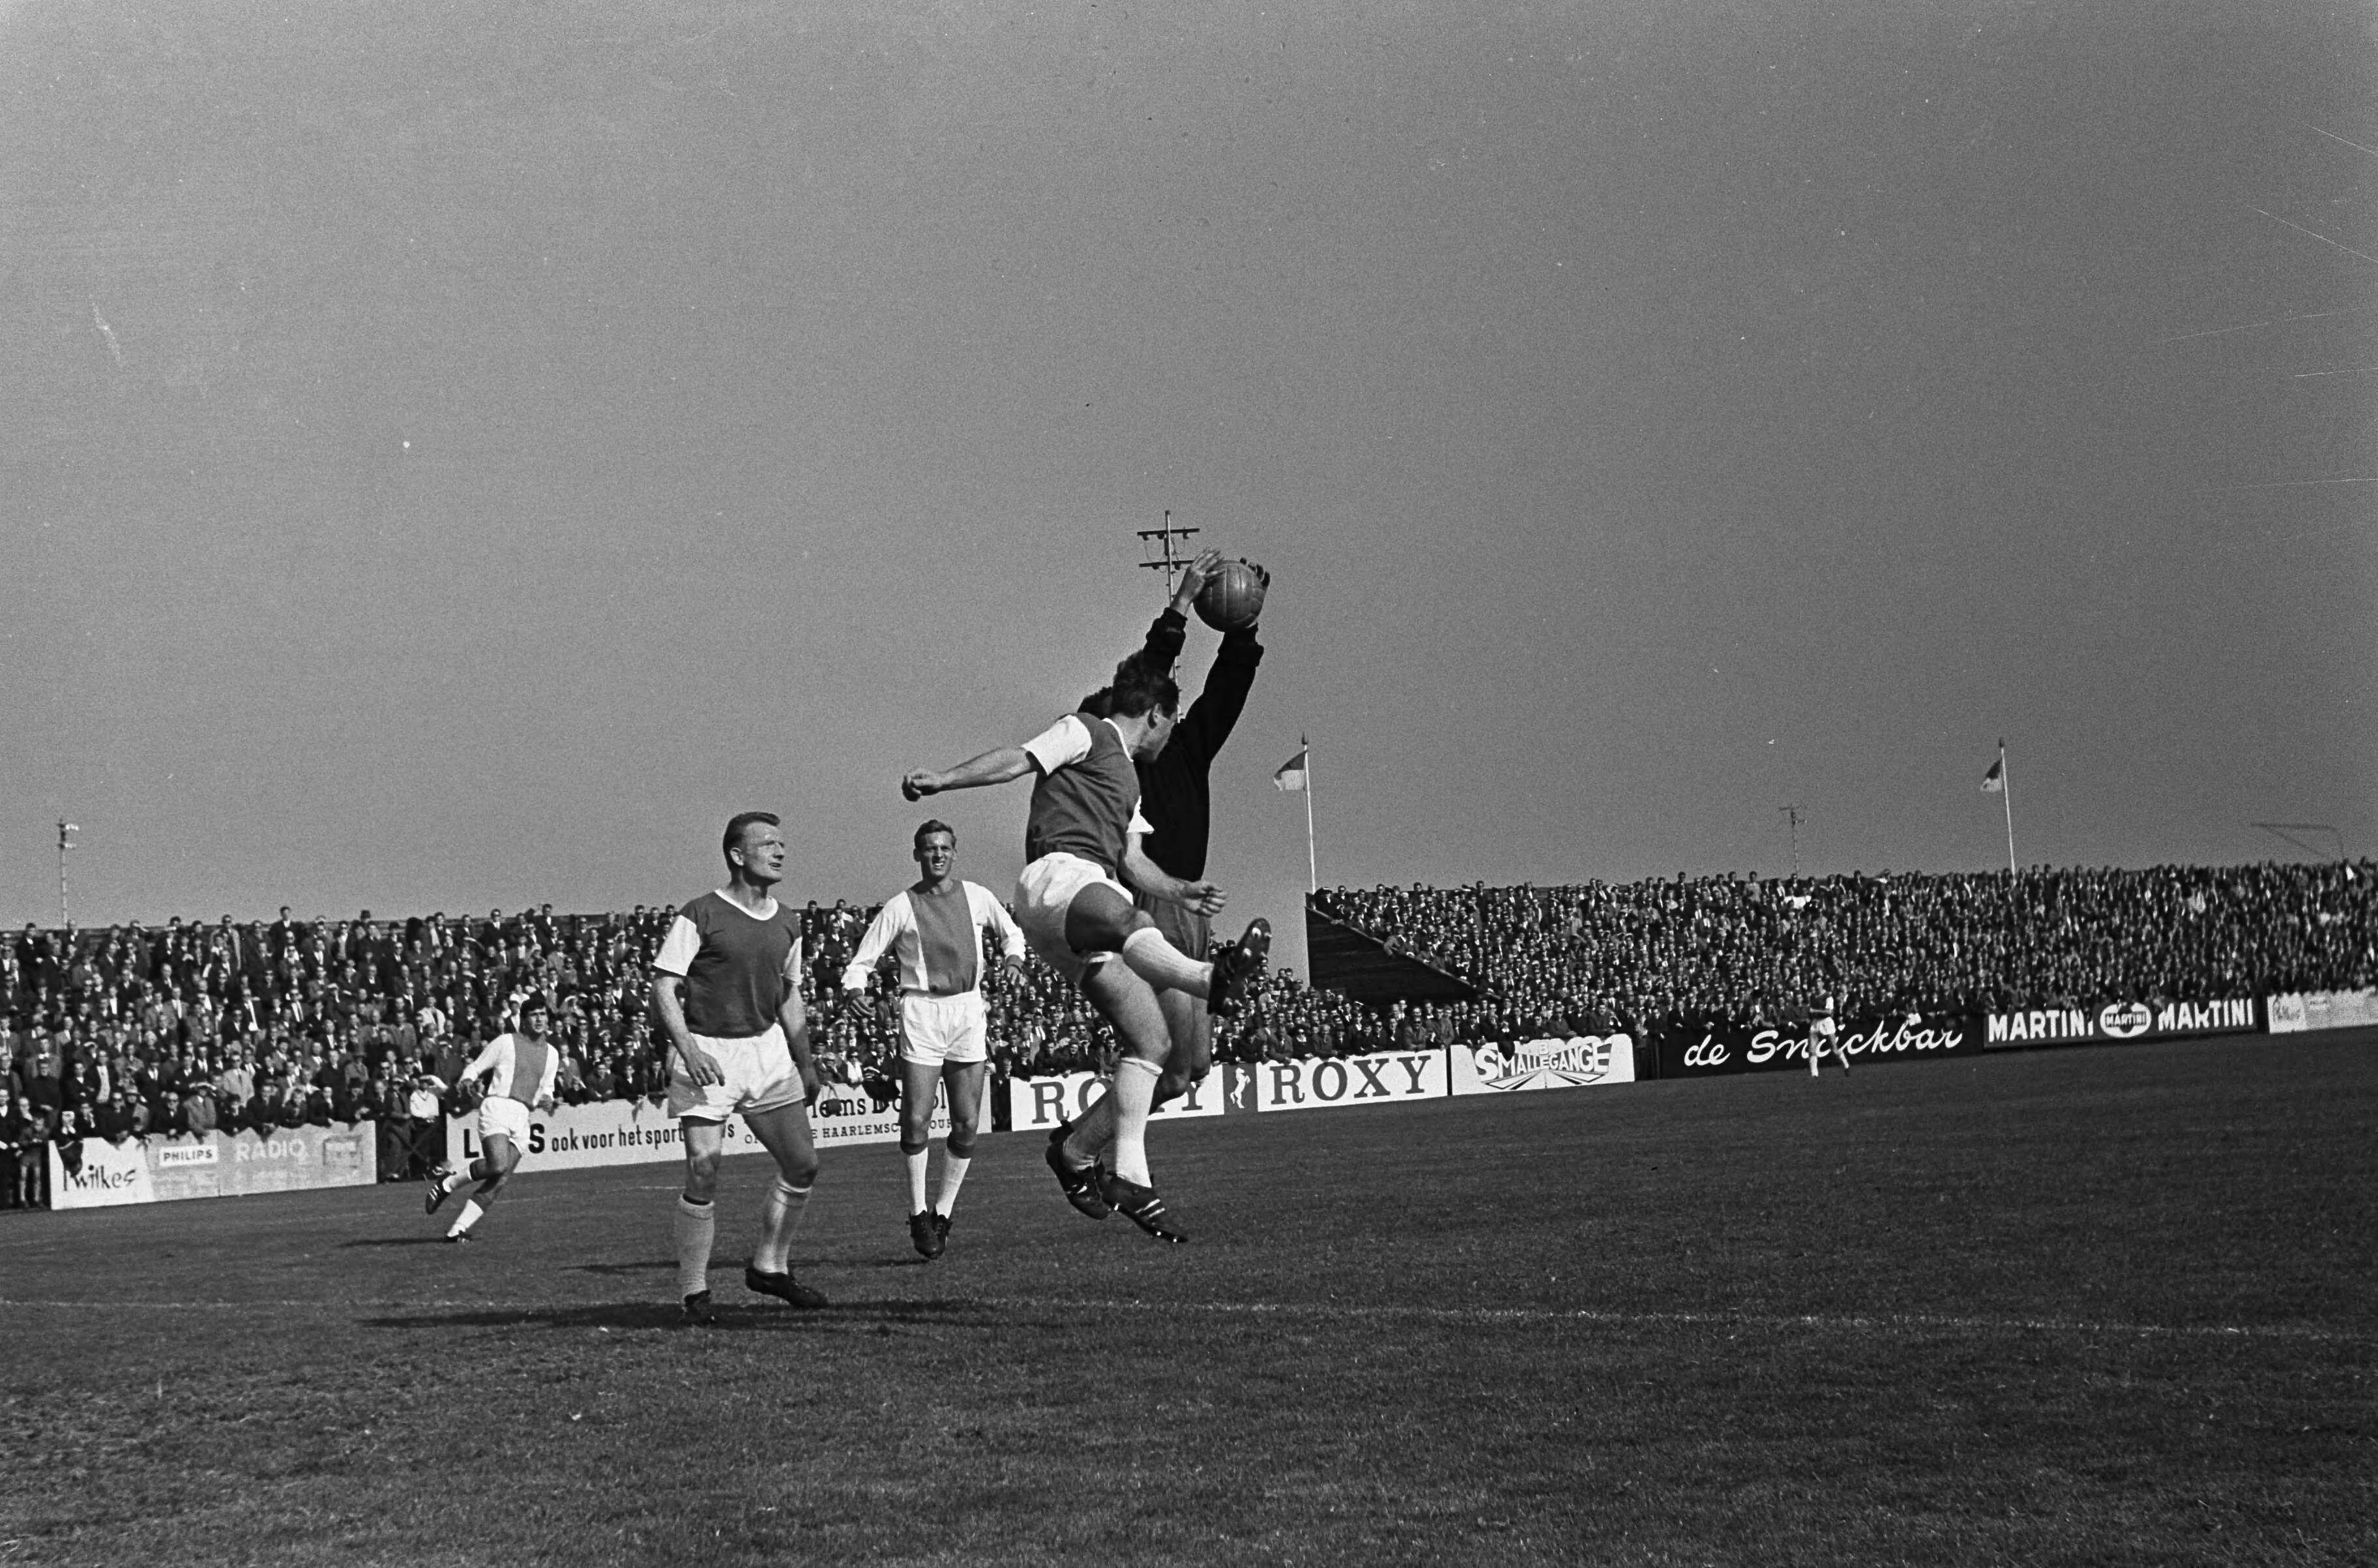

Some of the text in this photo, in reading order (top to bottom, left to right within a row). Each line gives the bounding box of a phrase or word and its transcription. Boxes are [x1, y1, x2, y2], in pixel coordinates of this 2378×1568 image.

[2105, 1011, 2147, 1028] MARTINI
[1475, 1043, 1610, 1081] SMALLEGANGE
[1684, 1034, 1730, 1066] de
[1270, 1055, 1431, 1105] ROXY
[1030, 1078, 1203, 1124] ROY
[164, 1149, 213, 1163] PHILIPS
[463, 1123, 545, 1158] LS
[551, 1127, 579, 1152] ook
[582, 1133, 614, 1150] voor
[619, 1124, 641, 1146] het
